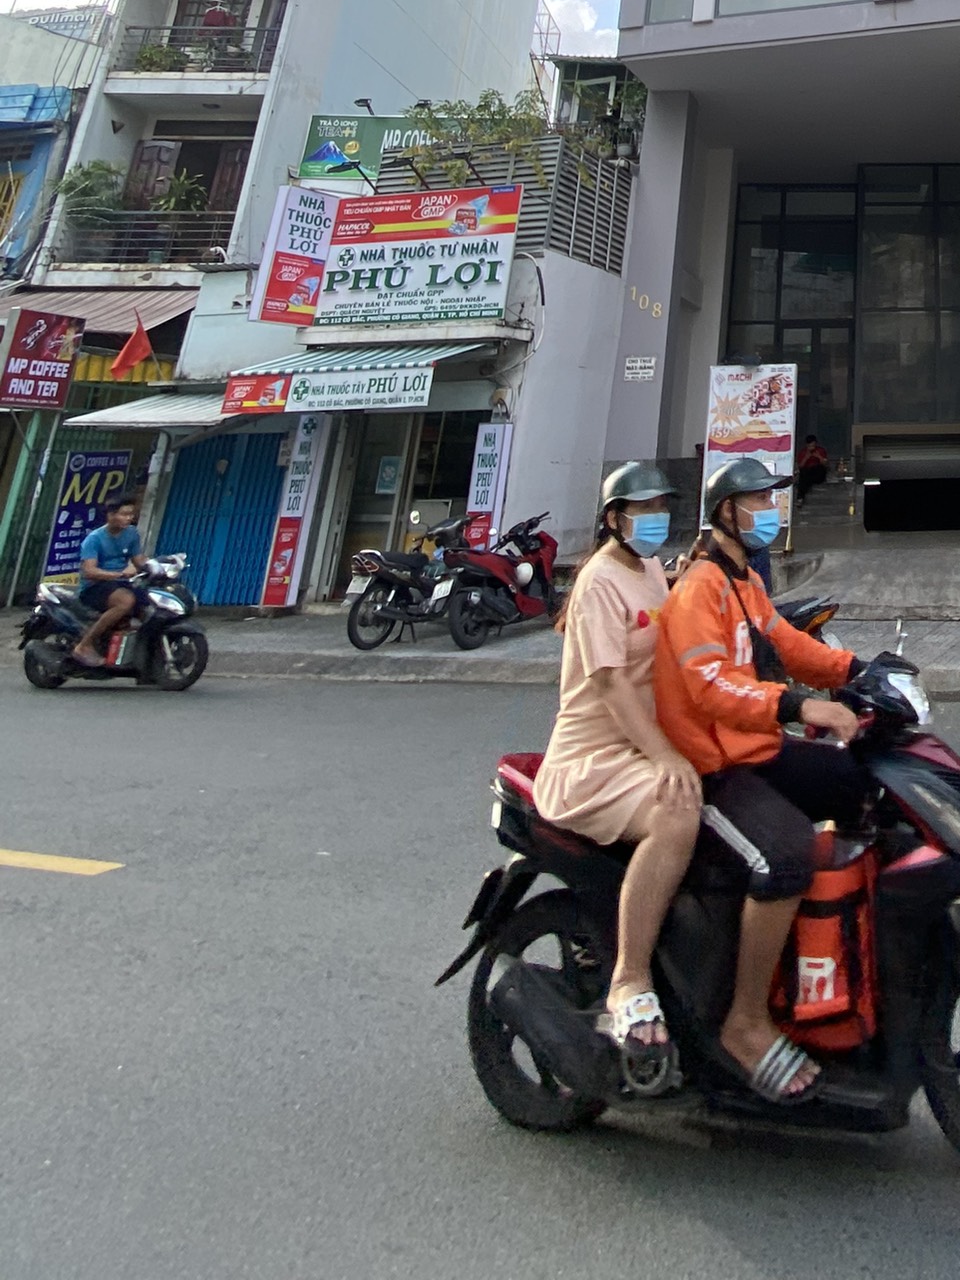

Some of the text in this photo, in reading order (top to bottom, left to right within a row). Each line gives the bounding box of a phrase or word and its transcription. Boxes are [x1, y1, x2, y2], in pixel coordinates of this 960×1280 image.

[28, 13, 95, 25] pullman
[380, 129, 401, 154] MP
[298, 195, 325, 212] NHÀ
[419, 195, 452, 209] JAPAN
[288, 208, 332, 229] THUỐC
[420, 206, 445, 218] GMP
[288, 224, 324, 241] PHÚ
[288, 238, 319, 255] LỢI
[359, 240, 499, 262] NHÀ THUỐC TƯ NHÂN
[323, 257, 503, 292] PHÚ LỢI
[427, 289, 444, 297] GPP
[630, 286, 662, 318] 108
[8, 357, 70, 378] MP COFFEE
[728, 373, 752, 381] MACHI
[8, 378, 58, 397] AND TEA
[311, 385, 325, 395] NHÀ
[326, 381, 350, 395] THUỐC
[366, 372, 398, 393] PHÚ
[402, 372, 428, 395] LỢI
[483, 428, 497, 449] NHÀ
[86, 456, 109, 467] COFFEE
[116, 456, 128, 465] TEA
[477, 449, 498, 468] THUỐC
[288, 475, 306, 493] PHÚ
[475, 468, 493, 487] PHÚ
[61, 470, 125, 506] MP
[474, 489, 489, 508] LỢI
